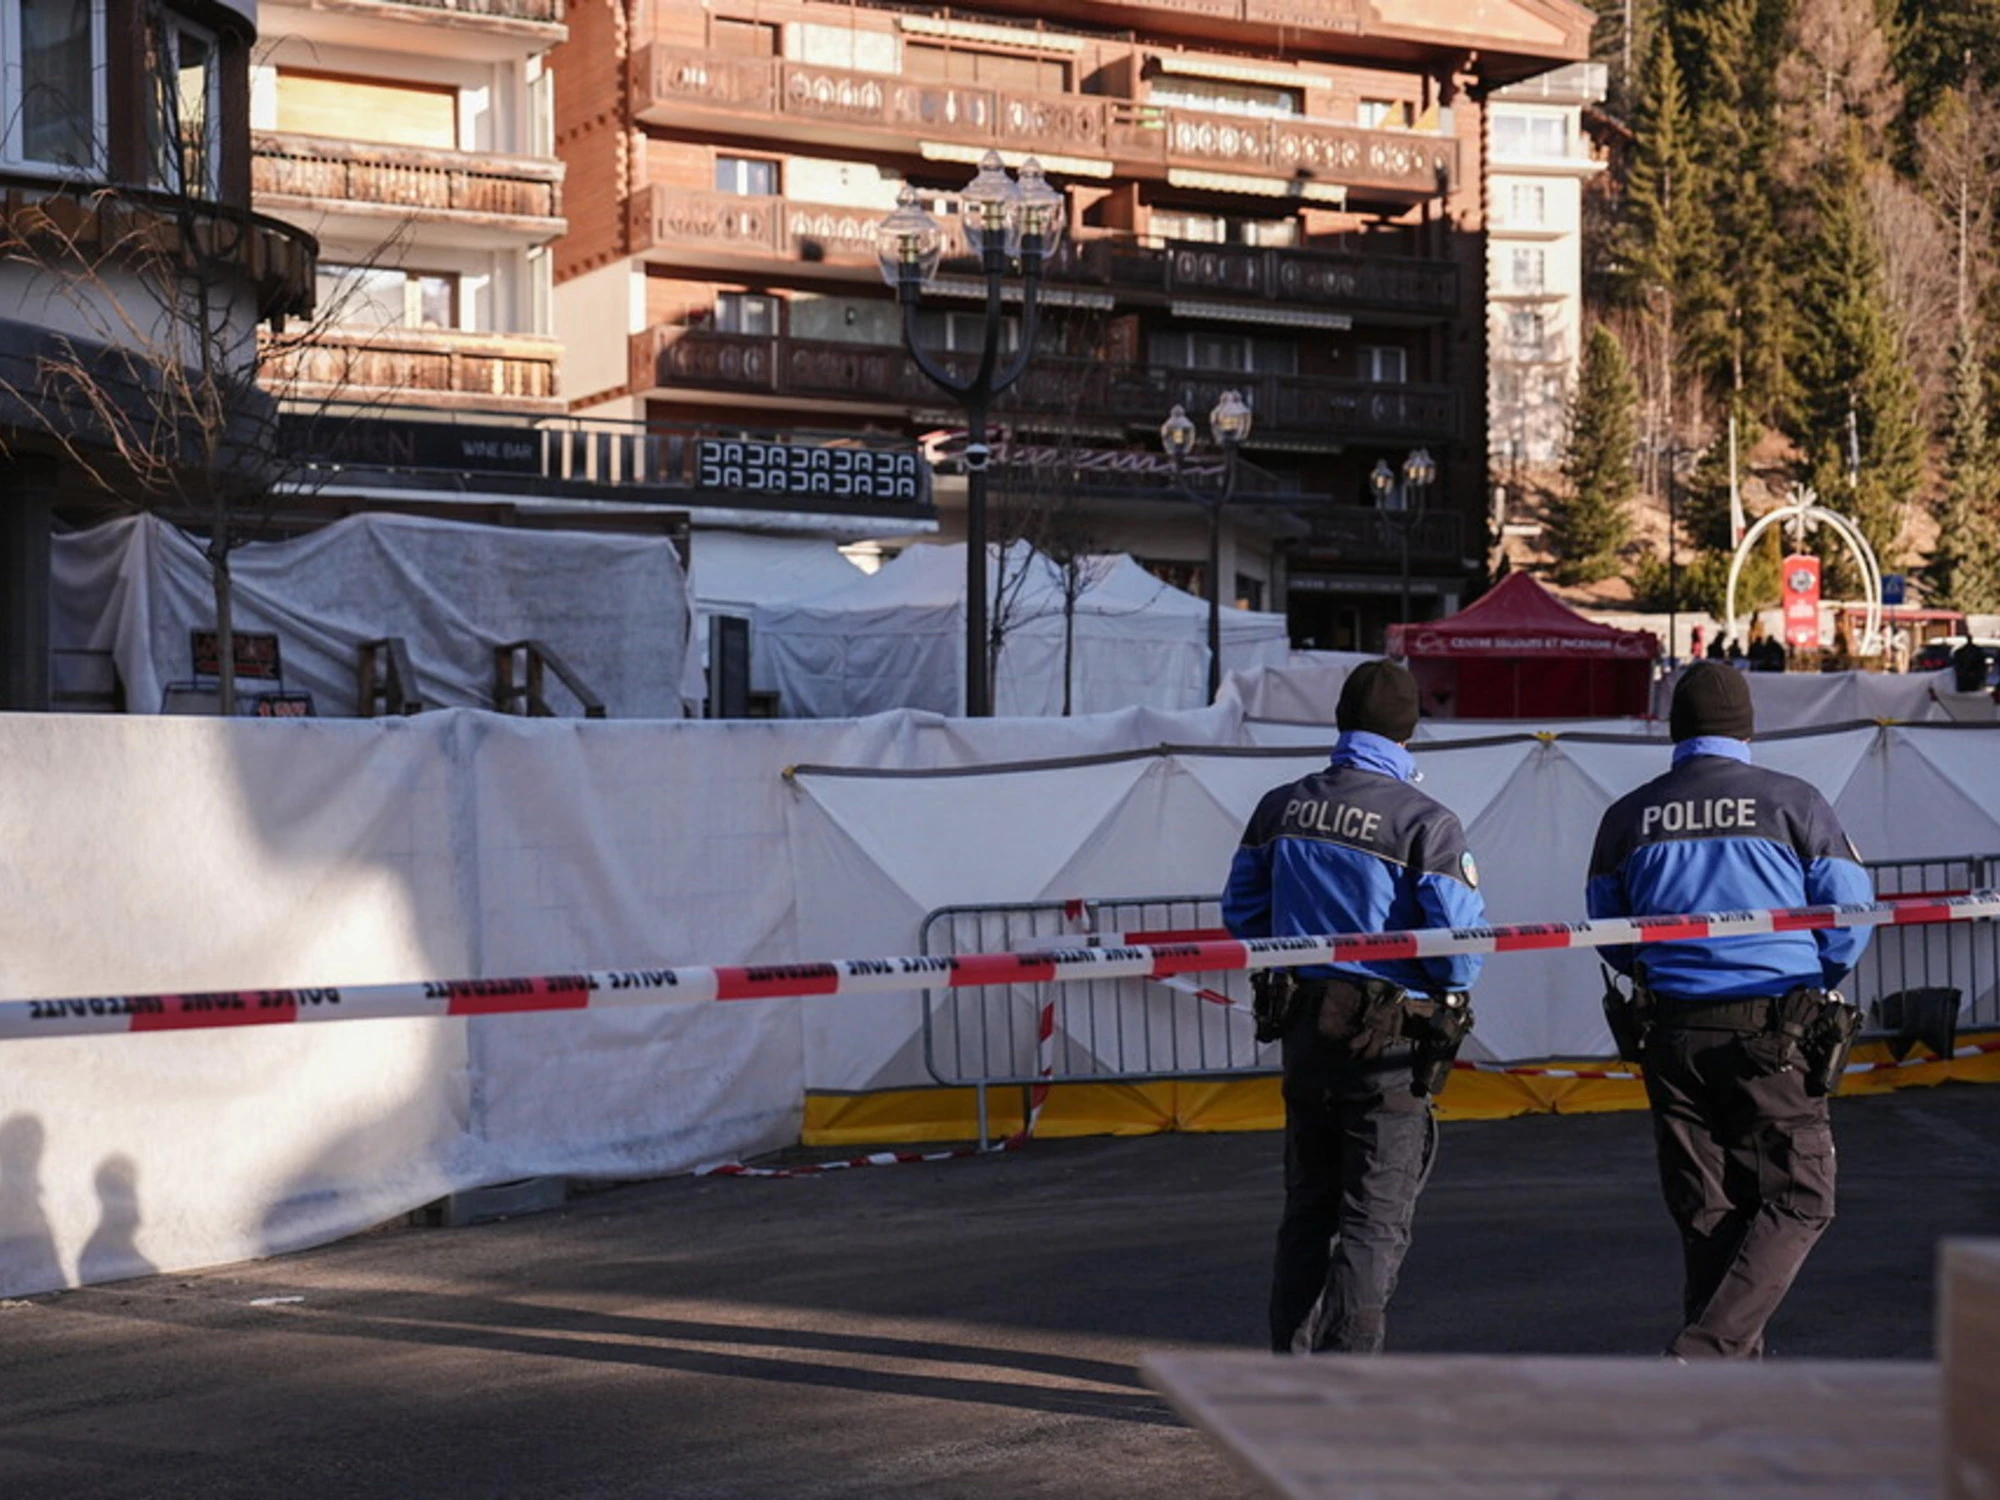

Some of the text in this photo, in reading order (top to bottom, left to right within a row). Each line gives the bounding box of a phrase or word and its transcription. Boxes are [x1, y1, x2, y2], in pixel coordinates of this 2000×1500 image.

[502, 442, 533, 460] BAR
[1281, 799, 1382, 842] POLICE
[1642, 798, 1757, 835] POLICE
